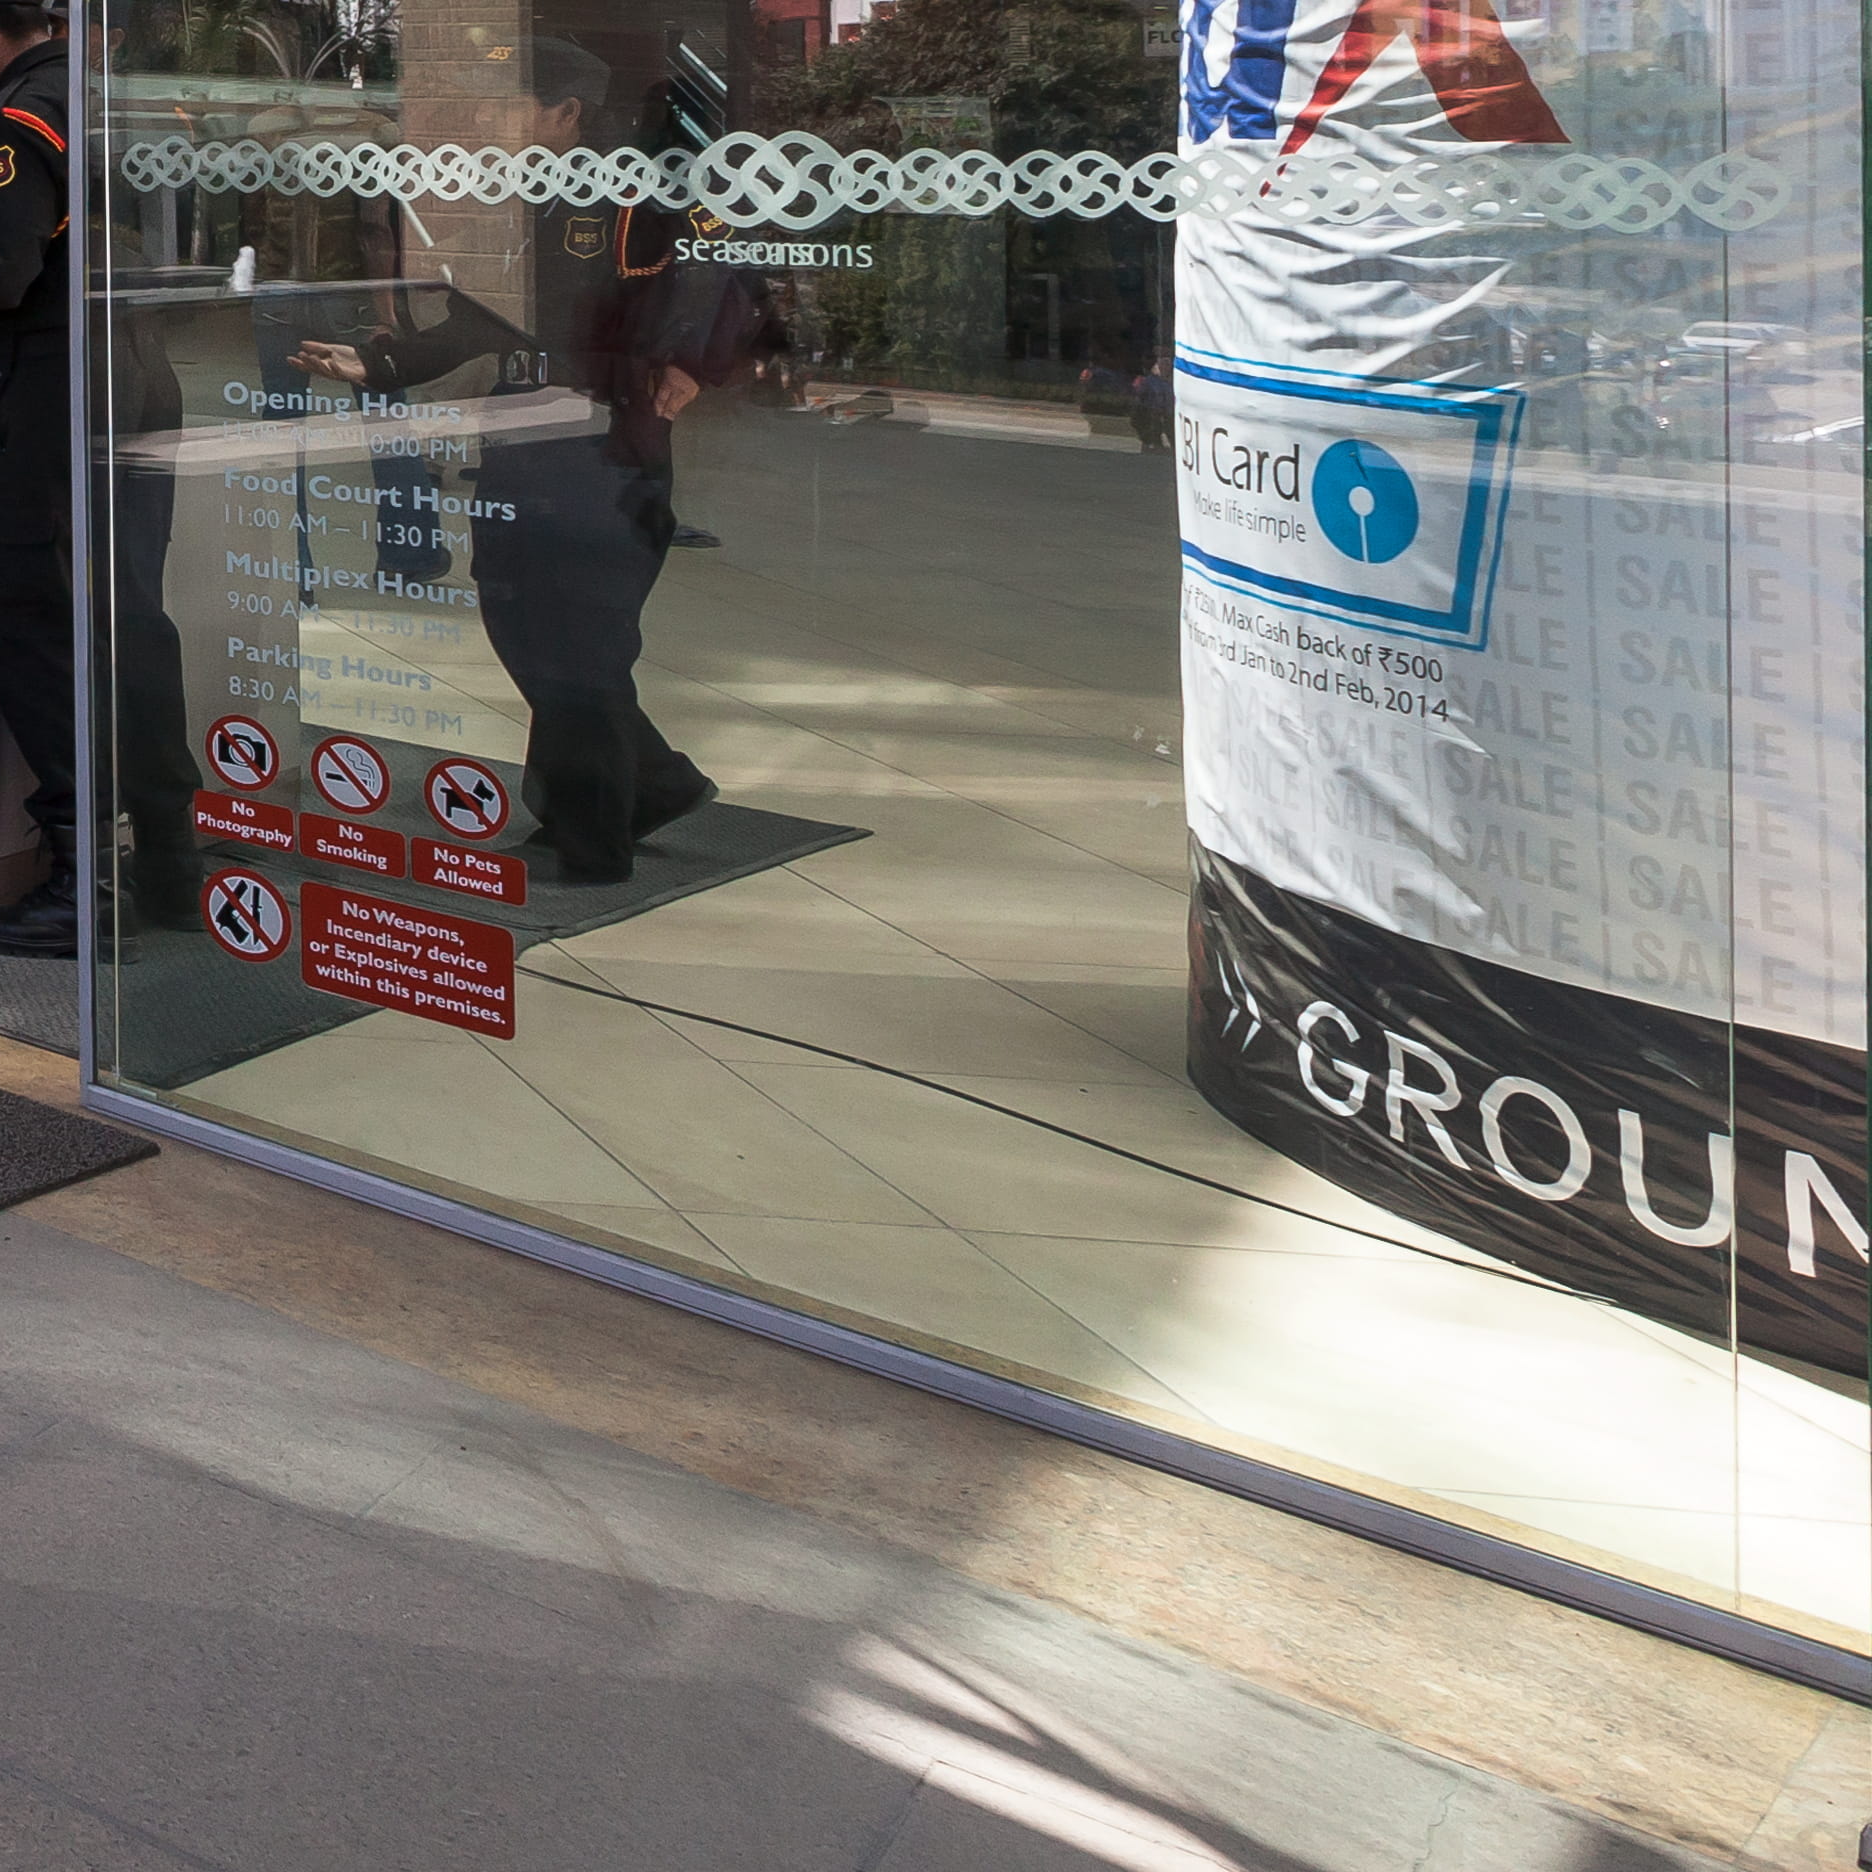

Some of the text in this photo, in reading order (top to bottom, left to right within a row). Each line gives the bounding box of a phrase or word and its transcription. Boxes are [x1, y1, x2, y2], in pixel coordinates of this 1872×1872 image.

[574, 231, 598, 244] BSS
[223, 381, 462, 425] Opening Hours
[360, 428, 420, 458] 10:00
[430, 439, 468, 464] PM
[1212, 427, 1301, 503] Card
[223, 466, 517, 522] Food Court Hours
[1193, 488, 1307, 544] Make life simple
[223, 503, 470, 554] 11:00 AM 11:30 PM
[226, 551, 477, 609] Multiplex Hours
[1616, 554, 1785, 627] SALE
[227, 591, 461, 645] 9:00 AM 11:30 PM
[1222, 603, 1444, 684] Max Cash back of ₹500
[227, 637, 432, 692] Parking Hours
[1240, 646, 1266, 672] Jan
[1270, 655, 1285, 679] to
[1288, 661, 1329, 693] 2nd
[1335, 672, 1380, 710] Feb,
[1384, 686, 1450, 723] 2014
[1618, 629, 1787, 703] SALE
[228, 676, 462, 735] 8:30 AM 11:30 PM
[1622, 704, 1789, 779] SALE
[197, 812, 293, 848] Photography
[231, 800, 255, 818] No
[338, 824, 364, 842] No
[1625, 780, 1792, 860] SALE
[316, 839, 388, 870] Smoking
[433, 847, 501, 875] No Pets
[433, 867, 504, 896] Allowed
[342, 900, 465, 946] No Weapons,
[1627, 854, 1795, 938] SALE
[309, 940, 506, 1001] or Explosives allowed
[327, 919, 488, 973] Incendiary device
[315, 964, 507, 1025] within this premises.
[1296, 999, 1868, 1278] GROUN
